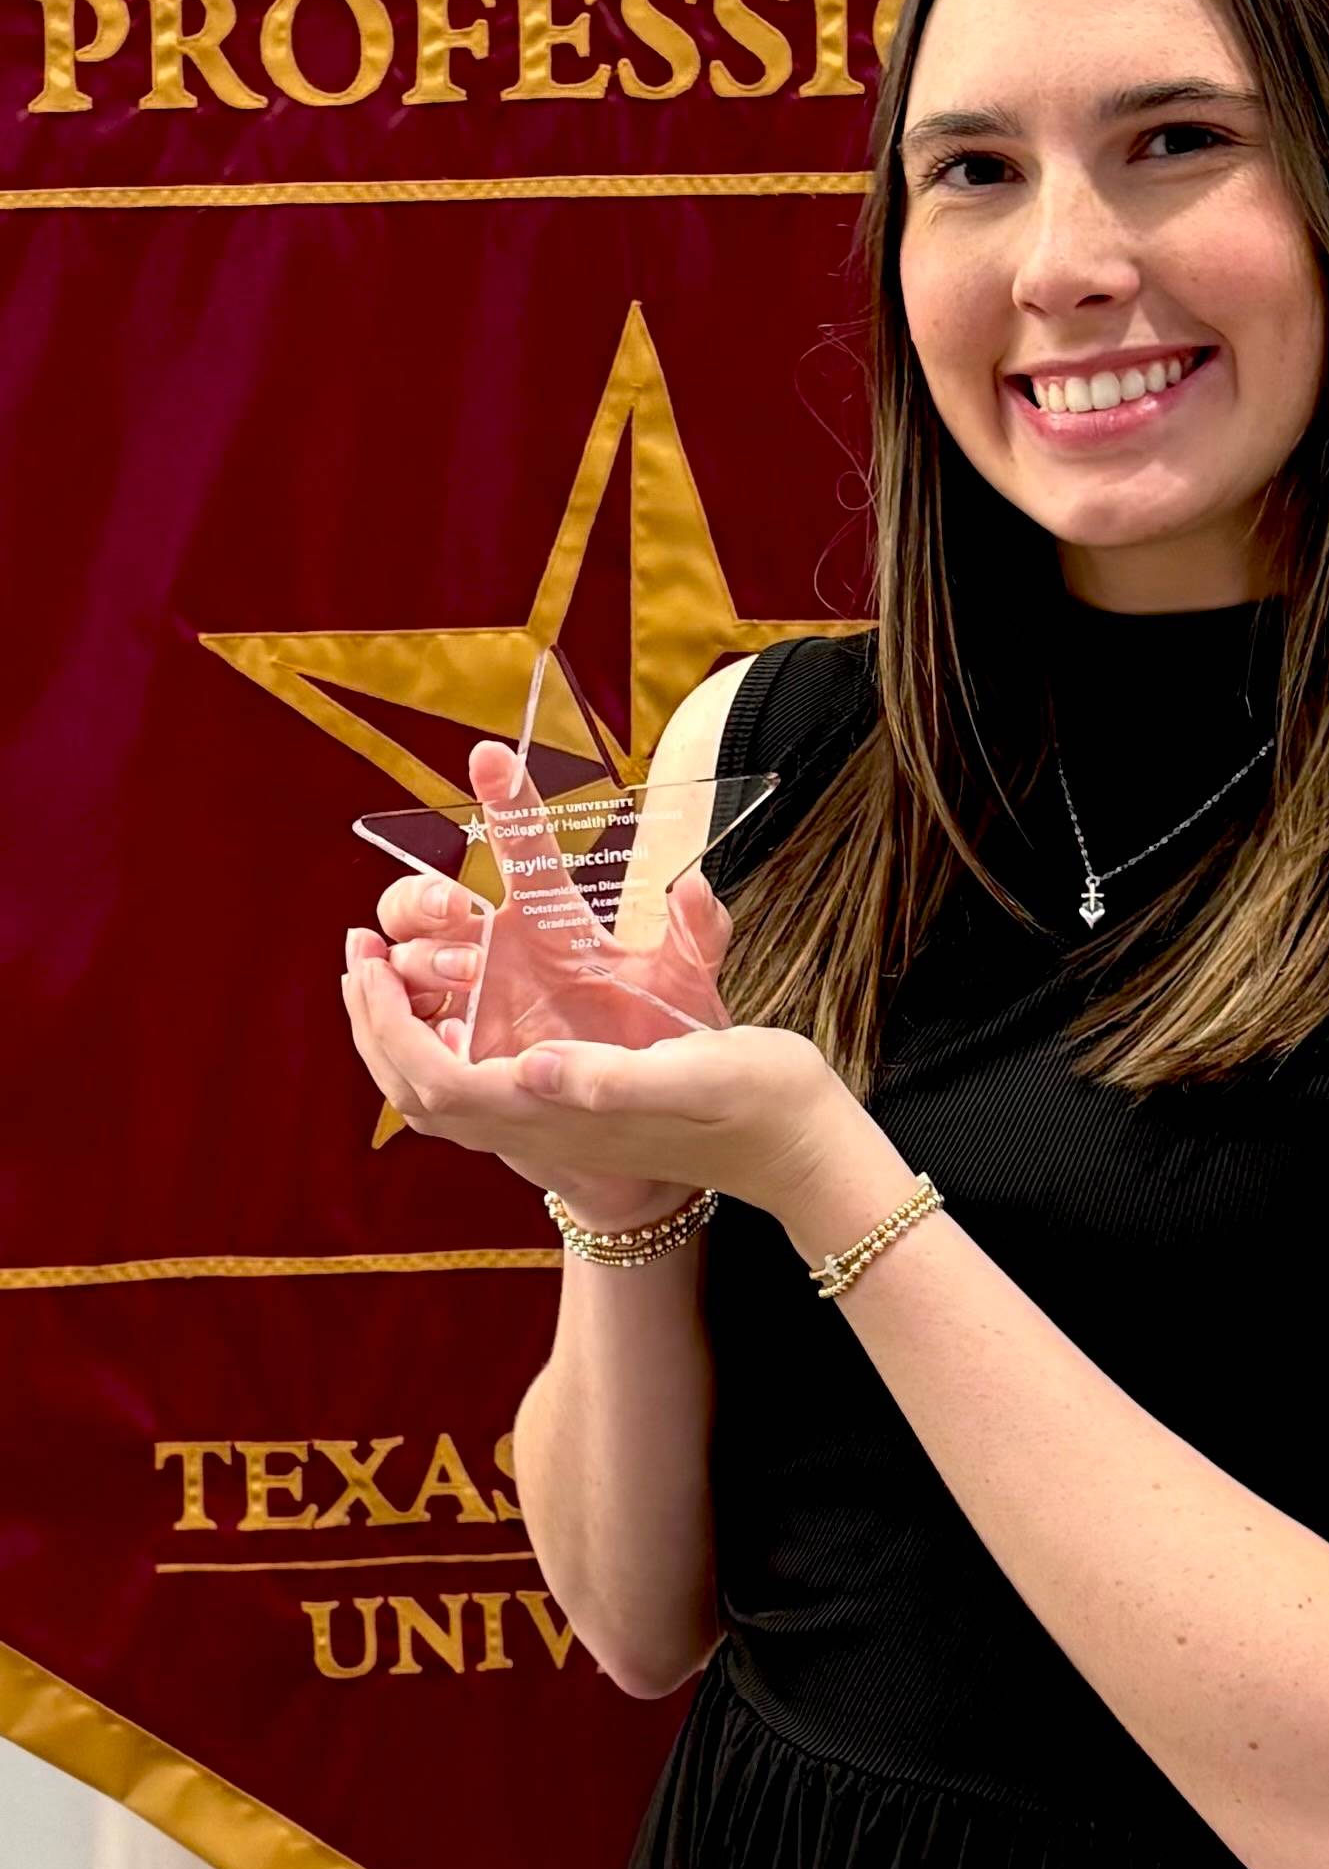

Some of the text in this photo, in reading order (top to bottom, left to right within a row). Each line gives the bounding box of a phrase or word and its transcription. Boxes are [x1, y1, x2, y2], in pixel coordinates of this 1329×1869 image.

[494, 797, 634, 820] TEXAS STATE UNIVERSITY
[494, 821, 544, 839] College
[546, 817, 560, 834] of
[562, 815, 606, 832] Health
[502, 855, 559, 877] Baylie
[571, 938, 601, 950] 2026
